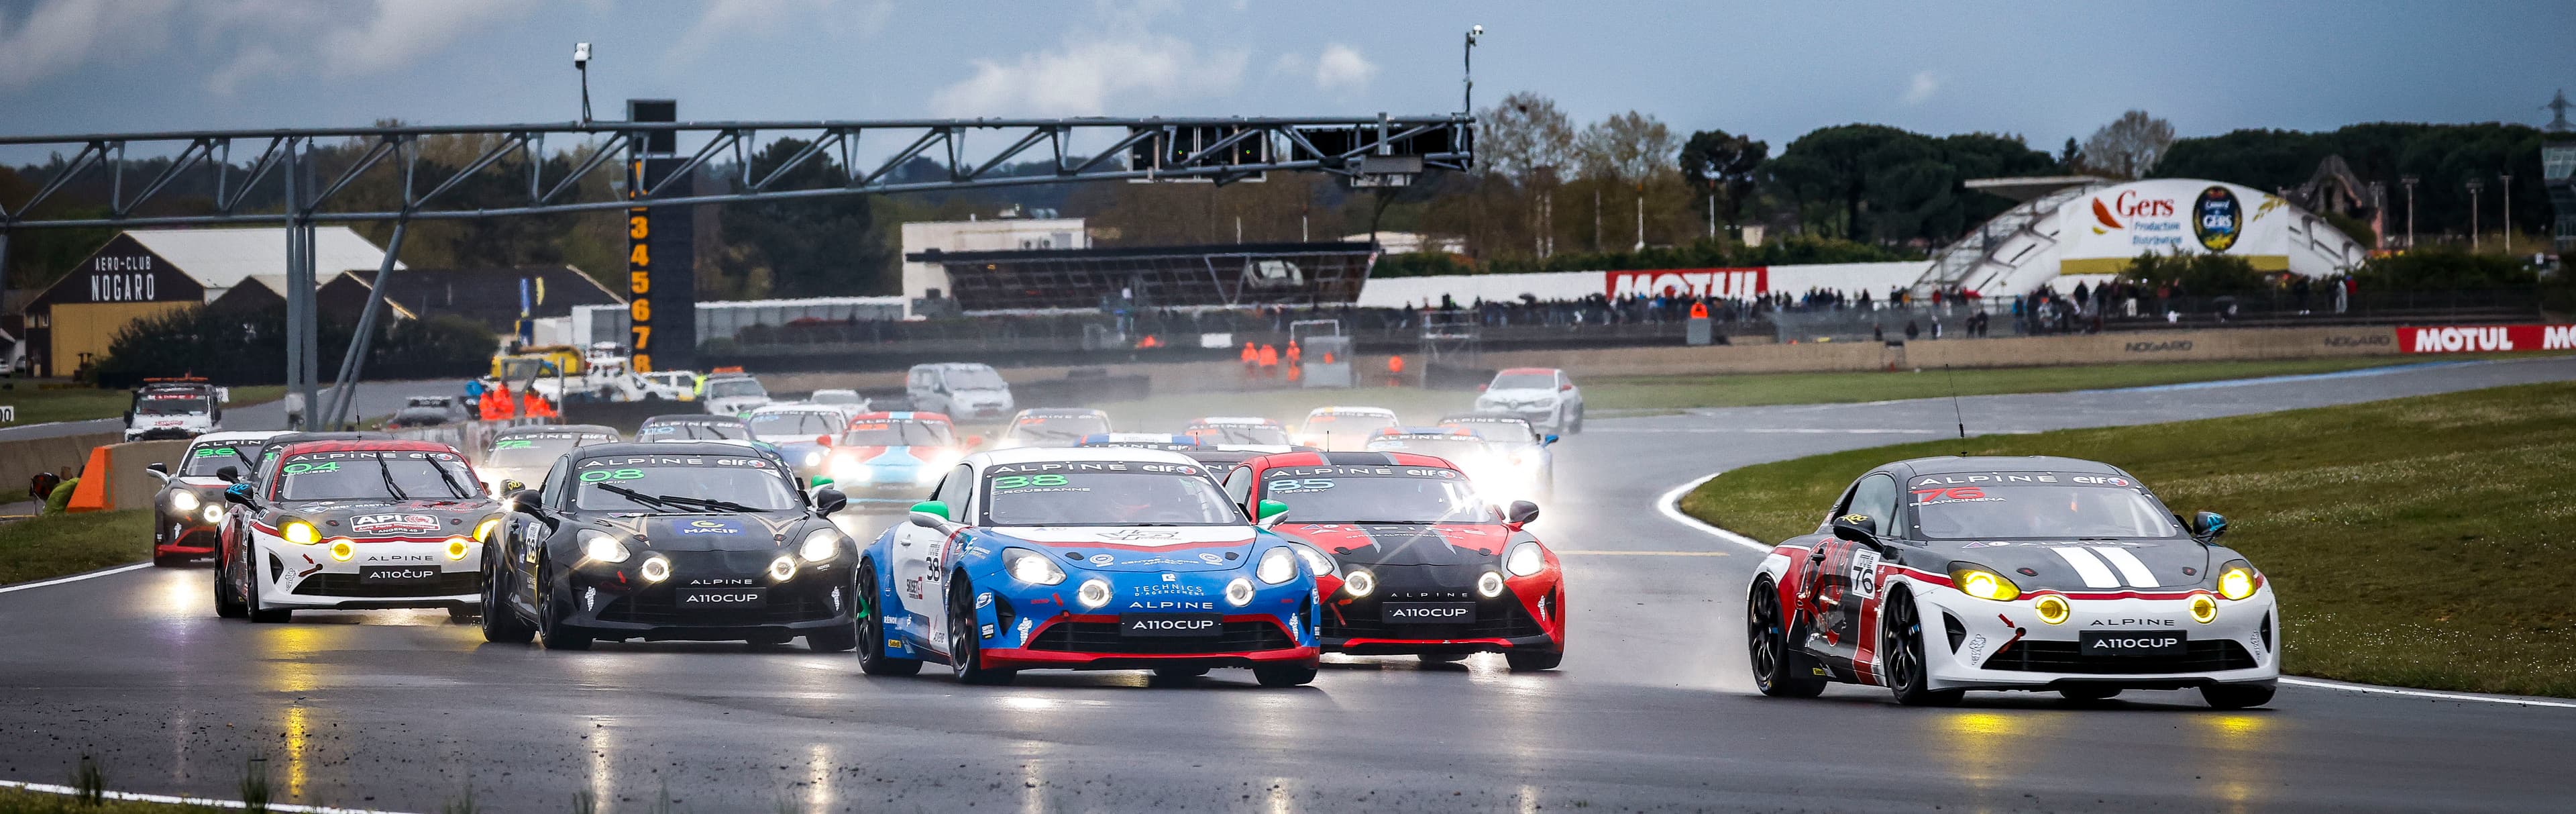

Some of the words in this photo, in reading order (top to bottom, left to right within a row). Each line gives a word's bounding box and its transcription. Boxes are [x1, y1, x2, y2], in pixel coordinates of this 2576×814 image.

[2116, 190, 2175, 217] Gers
[630, 215, 649, 240] 3
[630, 243, 649, 266] 4
[95, 256, 151, 271] AERO-CLUB
[91, 273, 154, 301] NOGARO
[631, 271, 650, 294] 5
[631, 299, 651, 321] 6
[632, 325, 651, 350] 7
[2415, 327, 2514, 352] MOTUL
[633, 354, 651, 374] 8
[197, 440, 261, 448] ALPIN
[194, 448, 236, 457] 36
[292, 452, 397, 462] ALPINE
[283, 462, 341, 474] 04
[585, 458, 704, 468] ALPINE
[994, 463, 1128, 474] ALPINE
[579, 468, 645, 482] 08
[1271, 468, 1393, 478] ALPINE
[995, 474, 1069, 490] 38
[1268, 478, 1336, 492] 85
[1919, 474, 2058, 486] ALPINE
[2073, 476, 2108, 485] elf
[991, 487, 1091, 496] C.ROUSSANNE
[1911, 487, 1986, 503] 76
[357, 514, 402, 525] API
[369, 570, 433, 578] A110CUP
[926, 556, 941, 582] 38
[1853, 565, 1874, 594] 76
[1134, 584, 1202, 593] TECHNICS
[686, 594, 758, 603] A110CUP
[1129, 601, 1214, 609] ALPINE
[1393, 609, 1466, 617] A110CUP
[1132, 620, 1214, 629] A110CUP
[2093, 638, 2178, 648] A110CUP
